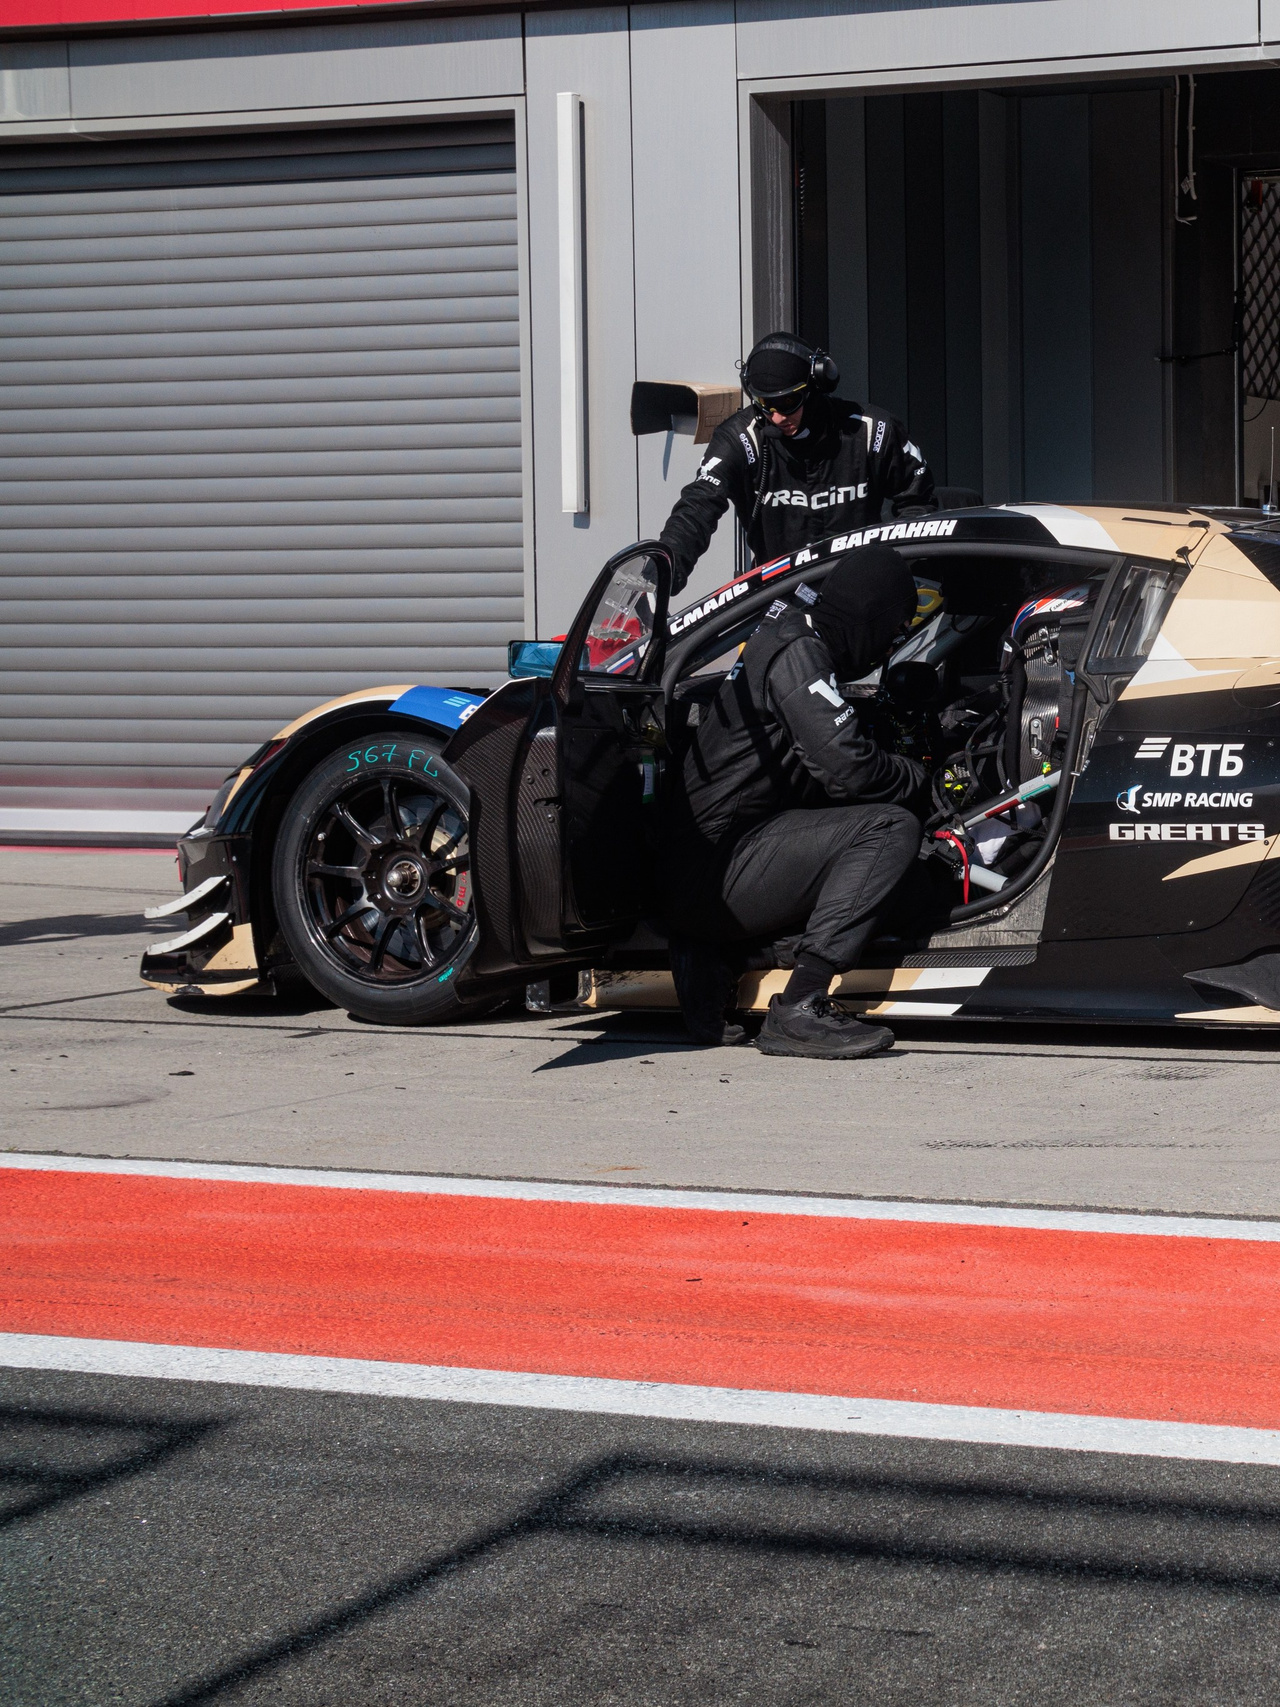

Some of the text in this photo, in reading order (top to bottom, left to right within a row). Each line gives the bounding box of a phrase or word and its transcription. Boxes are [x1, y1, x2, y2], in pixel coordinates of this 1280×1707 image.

[795, 519, 957, 567] А. ВАРТАНЯН
[669, 581, 749, 636] СМАЛЬ
[1170, 743, 1245, 777] ВТБ
[1142, 792, 1253, 808] SMP RACING
[1109, 823, 1265, 841] GREATS
